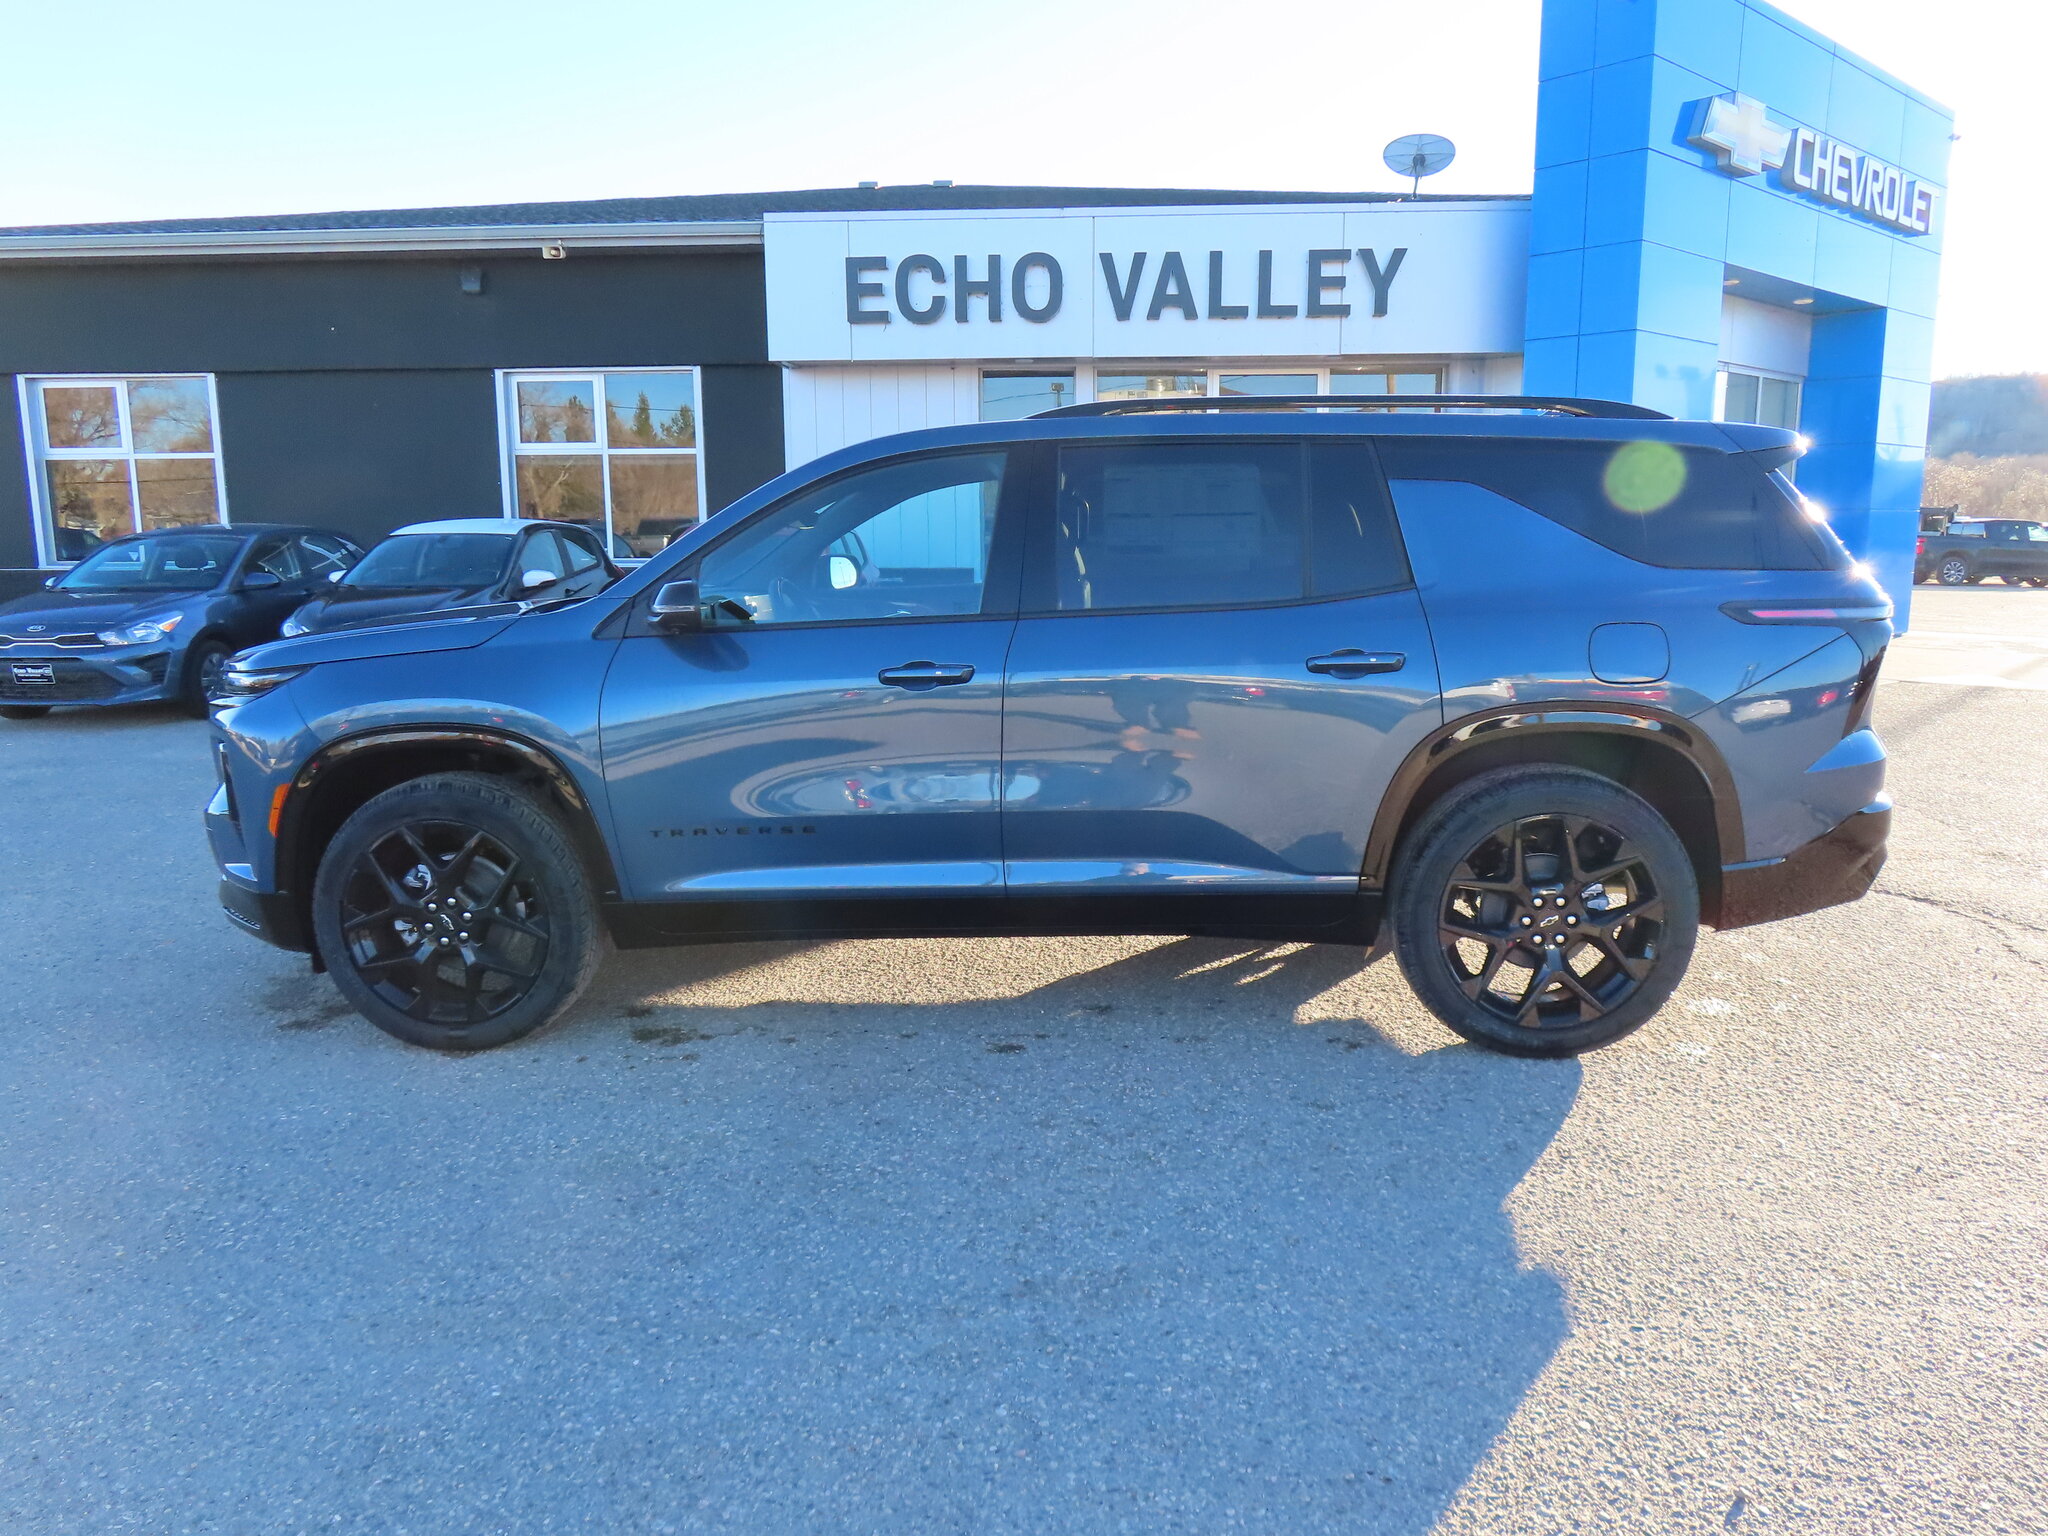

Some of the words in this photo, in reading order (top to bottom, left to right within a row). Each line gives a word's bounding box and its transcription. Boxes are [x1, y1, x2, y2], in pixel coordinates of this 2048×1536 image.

[1794, 127, 1940, 235] CHEVROLET
[845, 252, 1063, 325] ECHO
[1098, 248, 1408, 321] VALLEY
[650, 825, 816, 838] TRAVERSE
